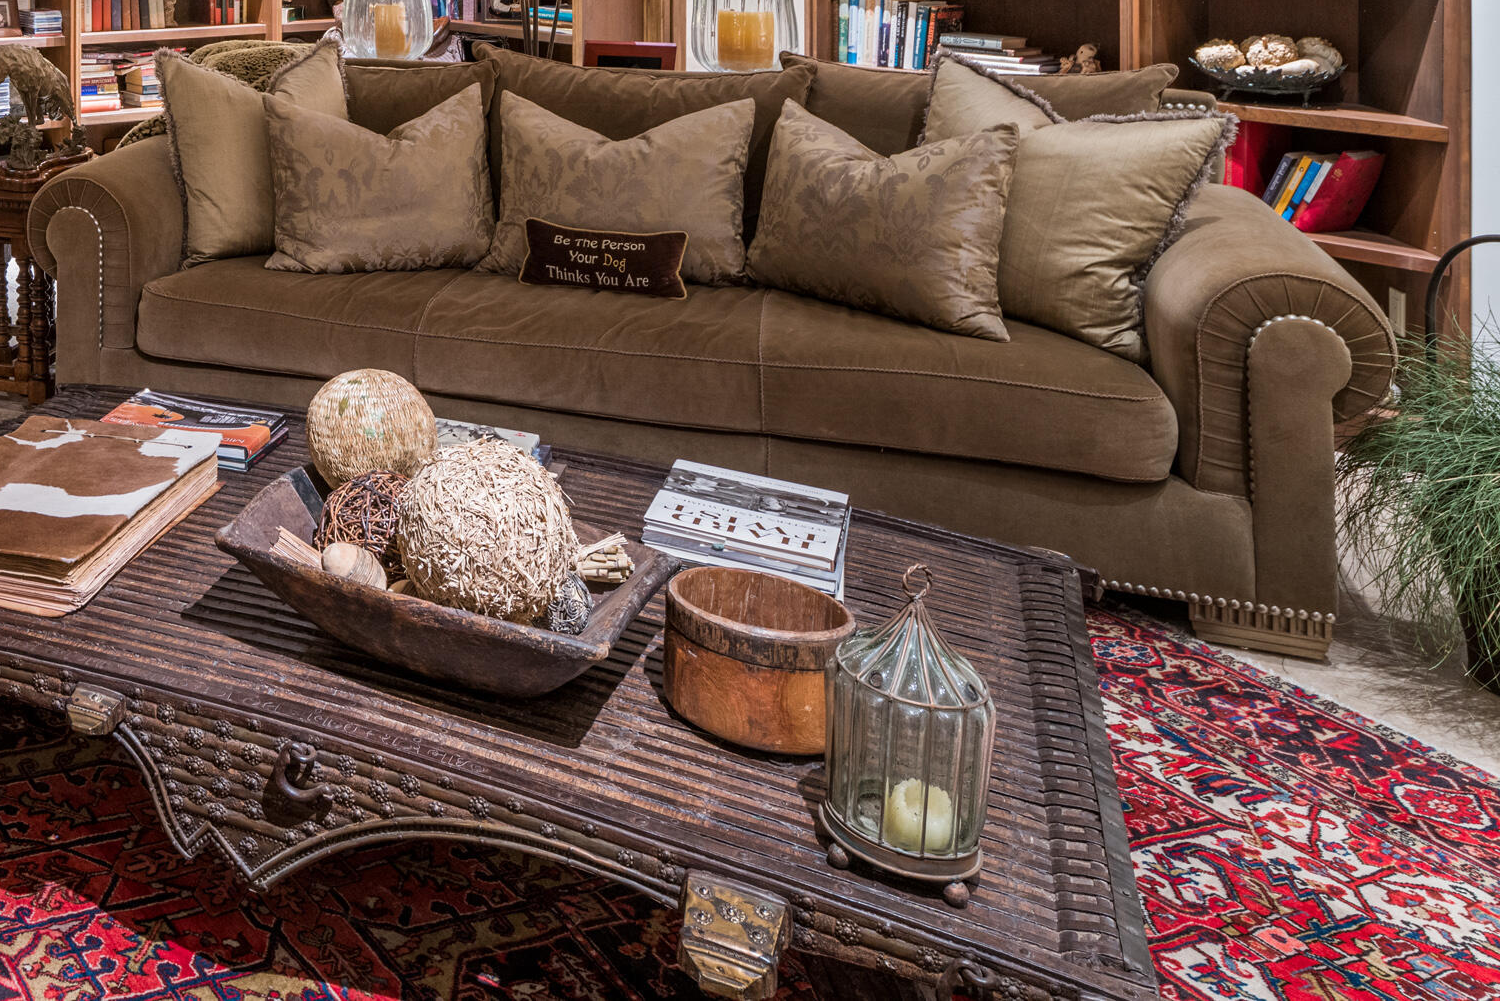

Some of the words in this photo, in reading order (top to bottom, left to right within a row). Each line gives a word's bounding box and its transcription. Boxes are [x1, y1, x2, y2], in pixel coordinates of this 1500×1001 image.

[554, 235, 570, 246] Be
[575, 238, 598, 248] The
[601, 239, 646, 251] Person
[569, 250, 598, 264] Your
[603, 253, 626, 273] Dog
[546, 264, 590, 284] Thinks
[595, 271, 619, 286] You
[625, 273, 649, 287] Are
